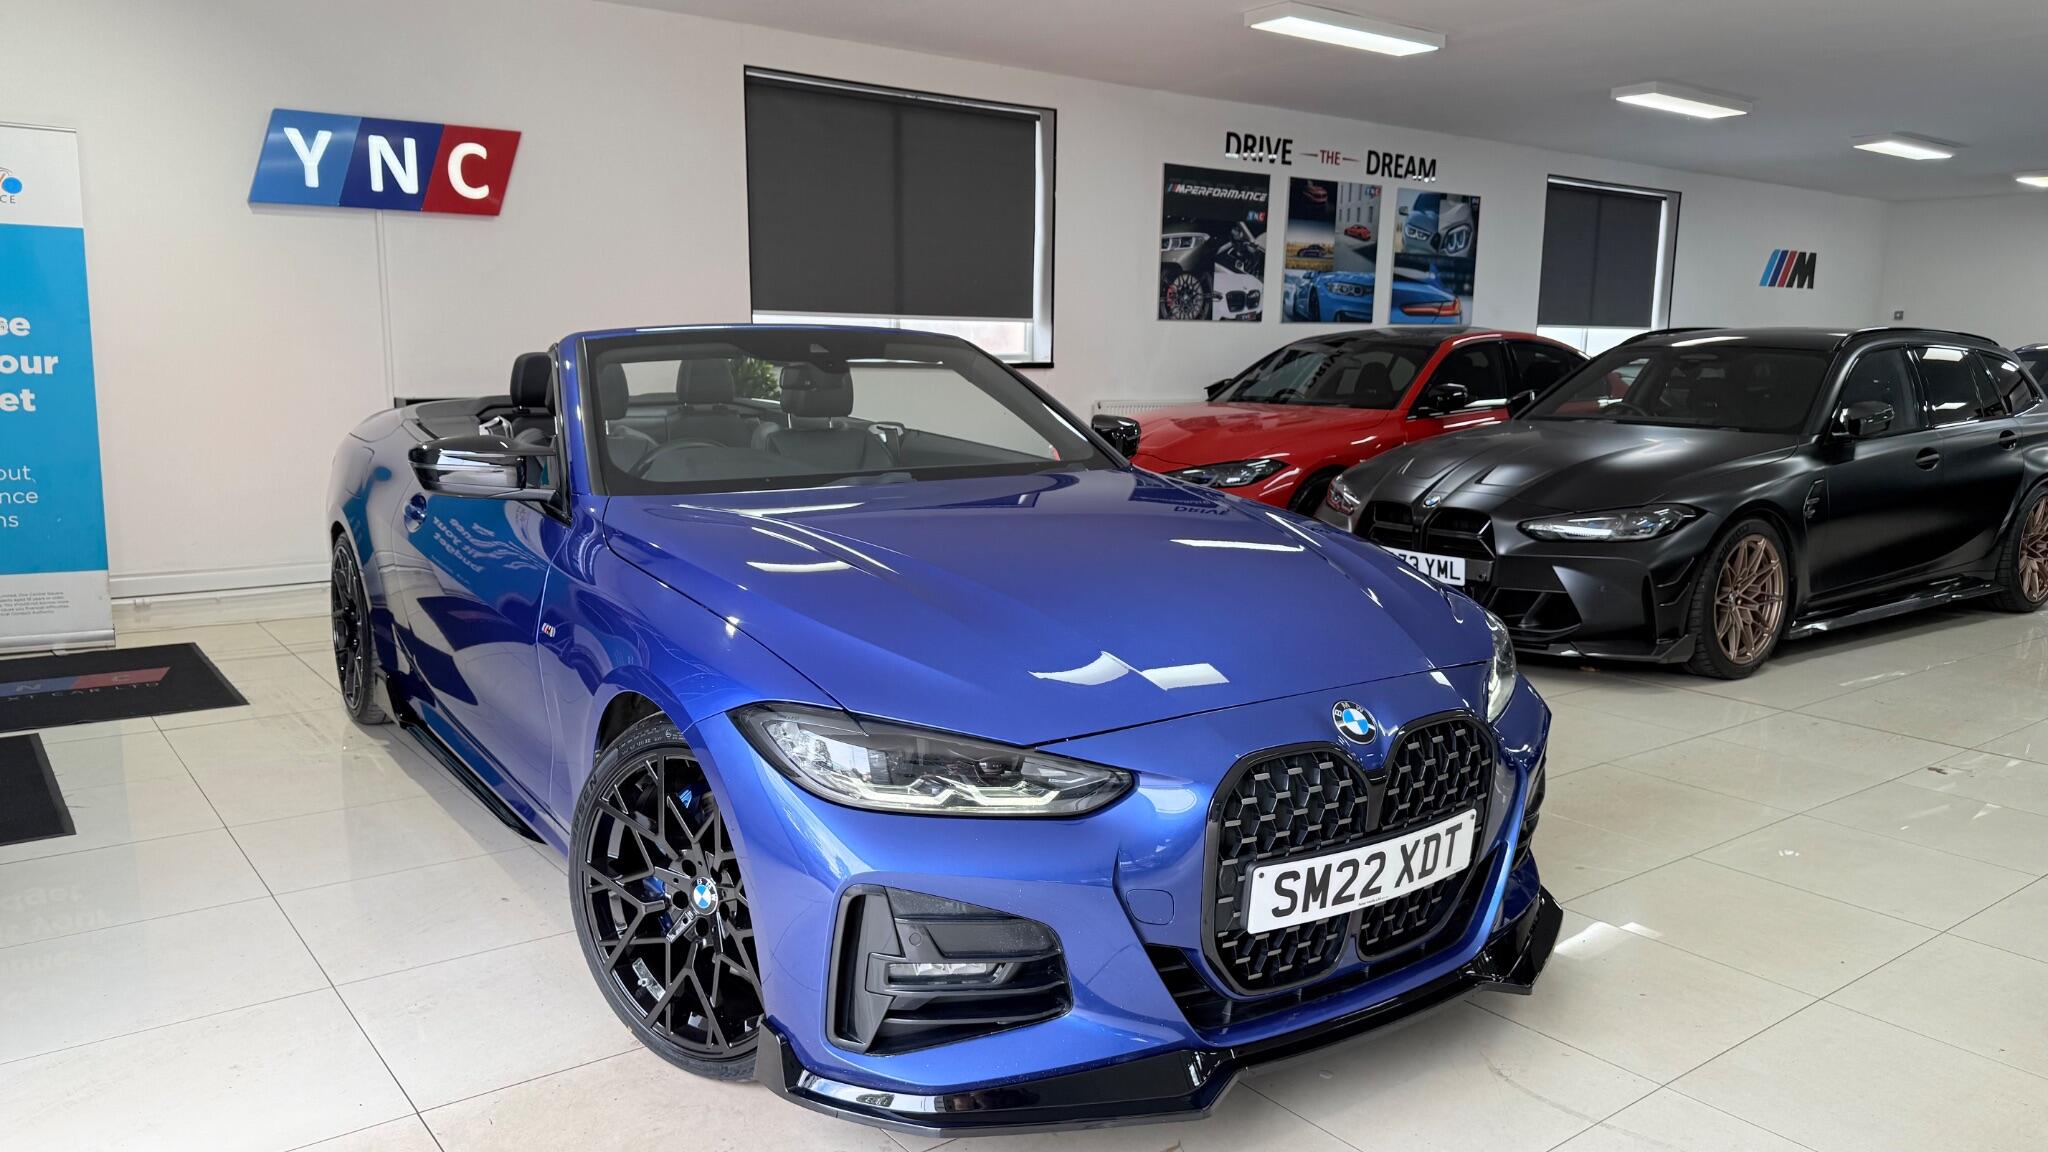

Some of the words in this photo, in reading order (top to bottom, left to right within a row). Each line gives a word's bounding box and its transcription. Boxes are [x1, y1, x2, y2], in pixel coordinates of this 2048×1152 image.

[283, 127, 490, 200] YNC
[1225, 131, 1293, 165] DRIVE
[1319, 149, 1341, 165] THE
[1366, 150, 1437, 182] DREAM
[1425, 557, 1461, 580] YML
[1334, 702, 1364, 717] BMW
[1271, 850, 1387, 918] SM22
[1394, 822, 1463, 889] XDT
